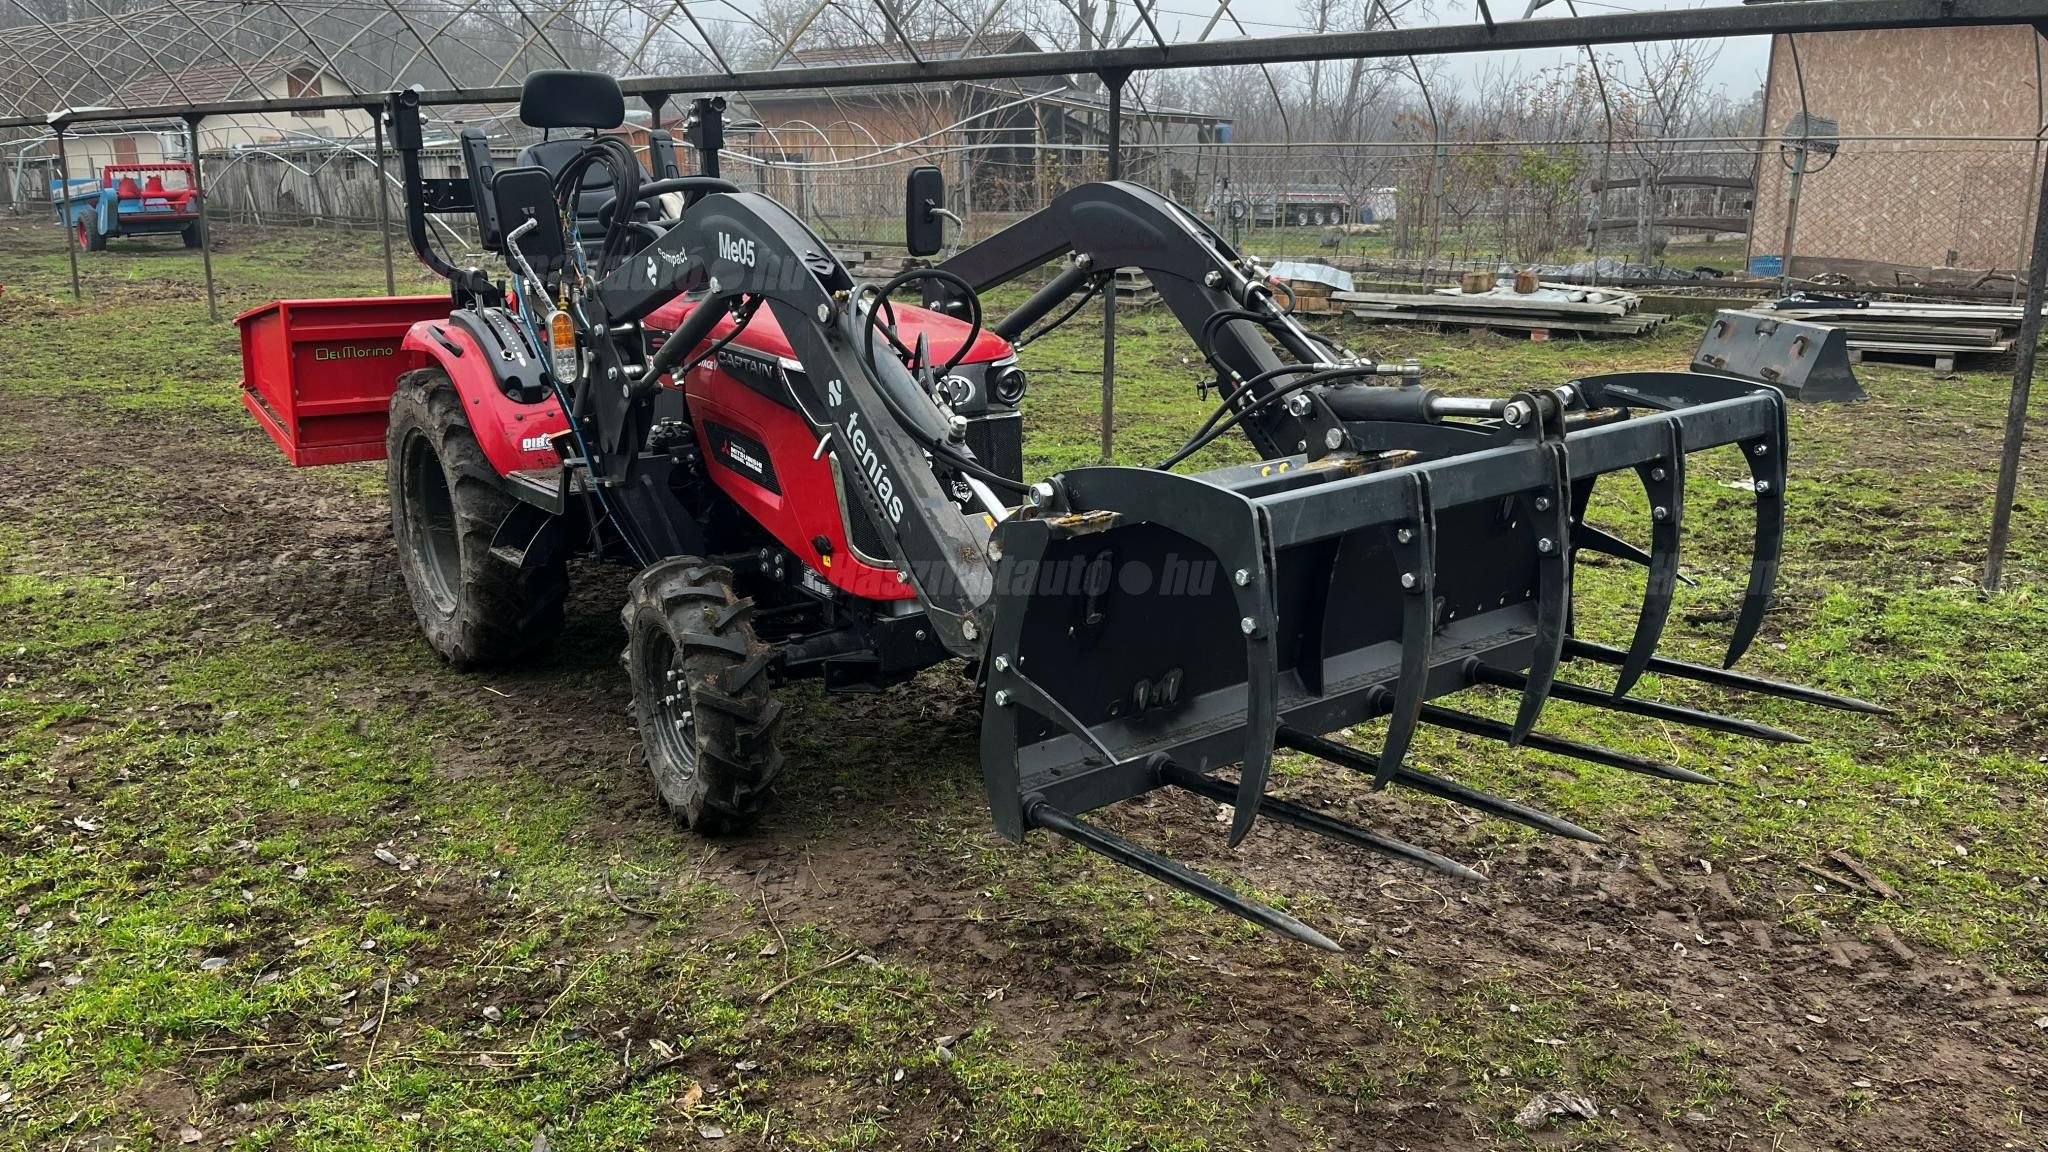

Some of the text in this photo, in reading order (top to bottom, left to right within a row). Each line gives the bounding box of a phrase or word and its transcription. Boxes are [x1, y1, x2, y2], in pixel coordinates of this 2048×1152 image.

[658, 246, 688, 267] compact
[718, 232, 755, 268] Me05
[718, 351, 773, 378] CAPTAIN
